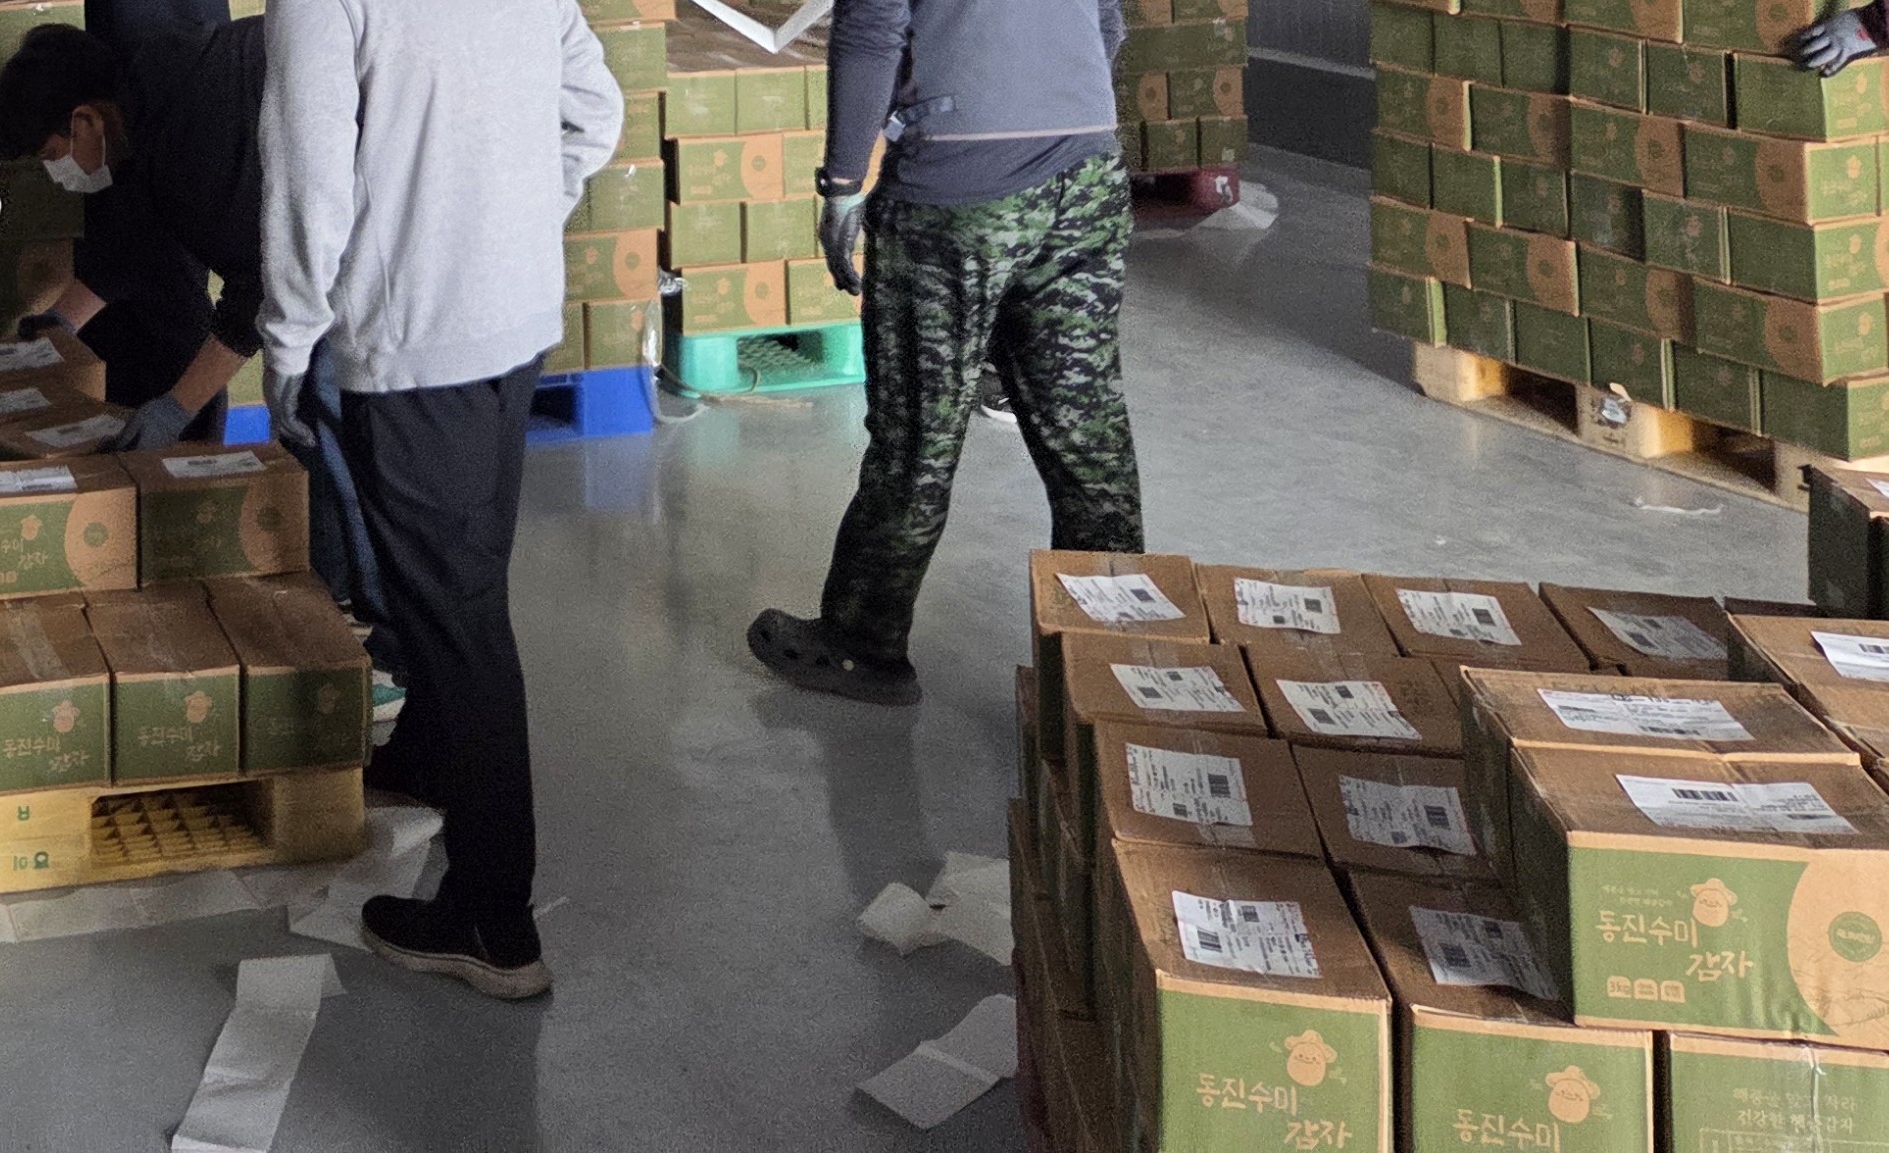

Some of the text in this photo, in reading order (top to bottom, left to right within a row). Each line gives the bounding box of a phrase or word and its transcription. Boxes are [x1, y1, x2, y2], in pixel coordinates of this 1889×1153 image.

[2, 736, 61, 759] 동진수미
[137, 725, 194, 747] 동진수미
[1595, 910, 1698, 948] 동진수미
[1685, 950, 1755, 982] 감자
[1195, 1073, 1298, 1116] 동진수미
[1284, 1120, 1353, 1150] 감자
[1452, 1109, 1561, 1153] 동진수미
